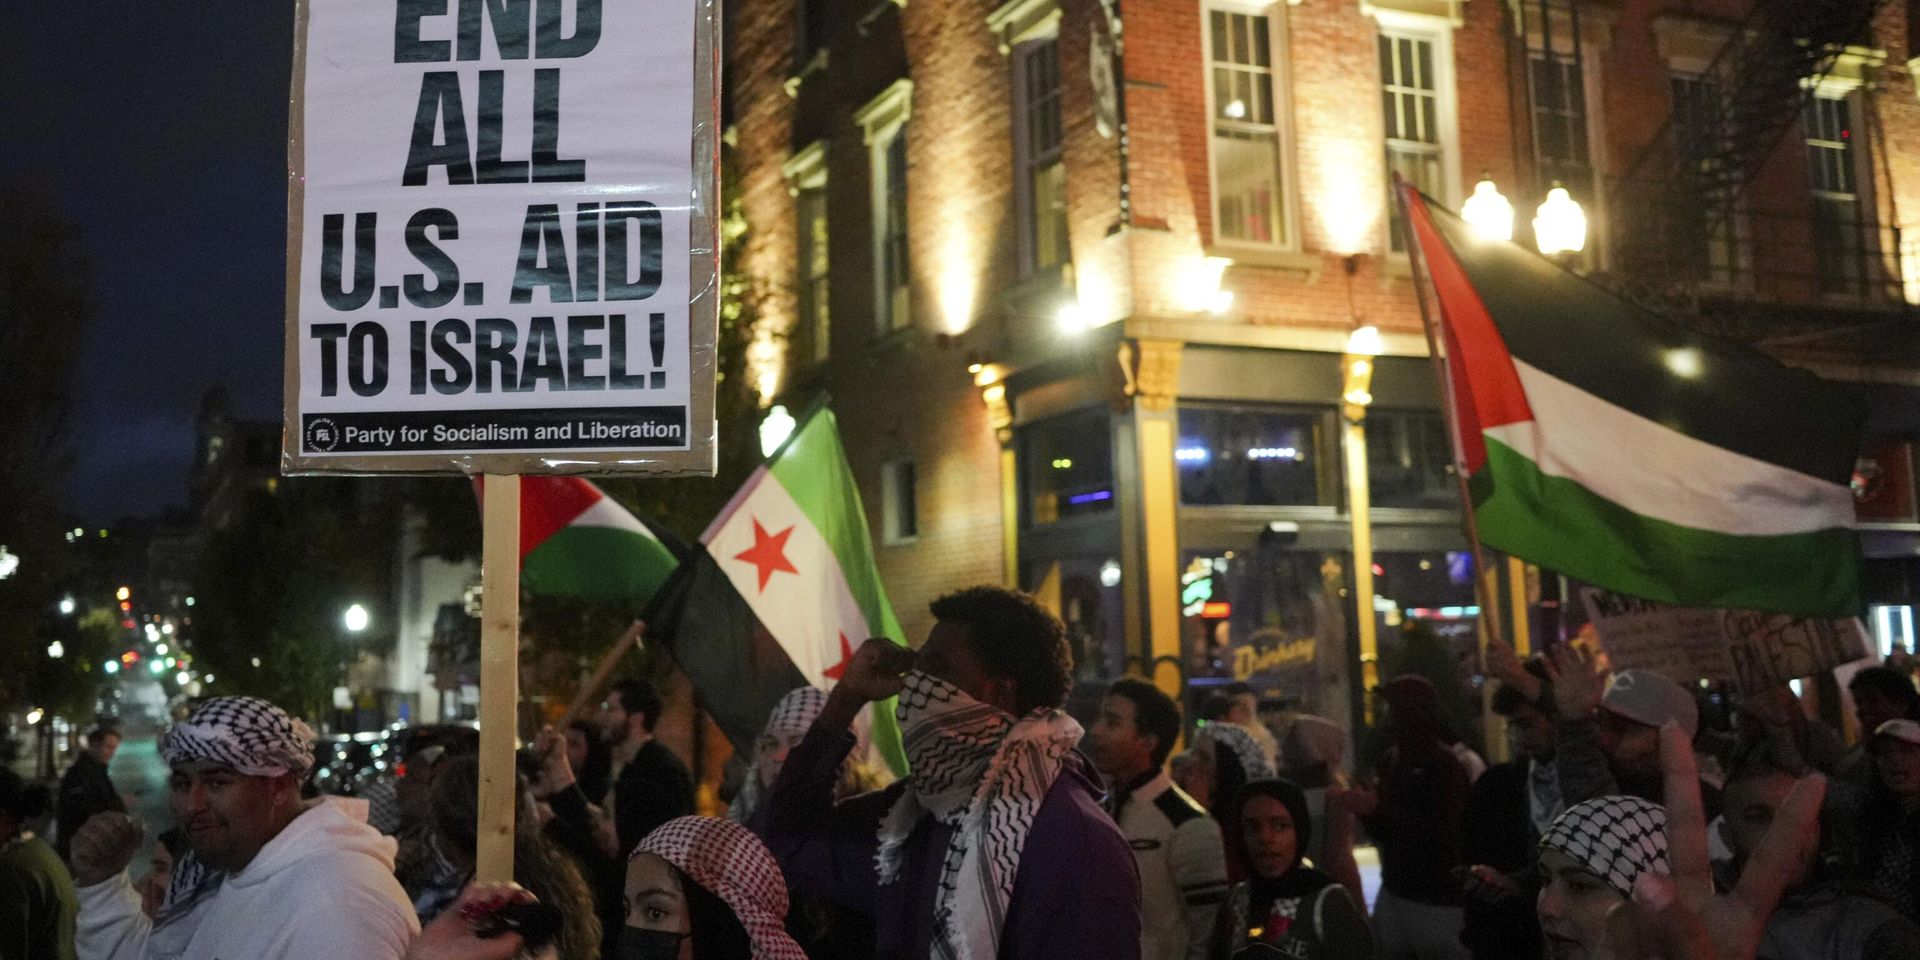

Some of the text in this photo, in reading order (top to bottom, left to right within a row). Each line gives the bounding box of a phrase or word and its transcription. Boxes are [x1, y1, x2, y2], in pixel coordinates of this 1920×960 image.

[394, 0, 602, 63] END
[402, 68, 586, 187] ALL
[320, 201, 663, 311] U.S. AID
[311, 313, 666, 397] TO ISRAEL!
[345, 425, 395, 446] Party
[400, 424, 428, 442] for
[433, 423, 528, 442] Socialism
[534, 422, 571, 441] and
[578, 420, 681, 440] Liberation
